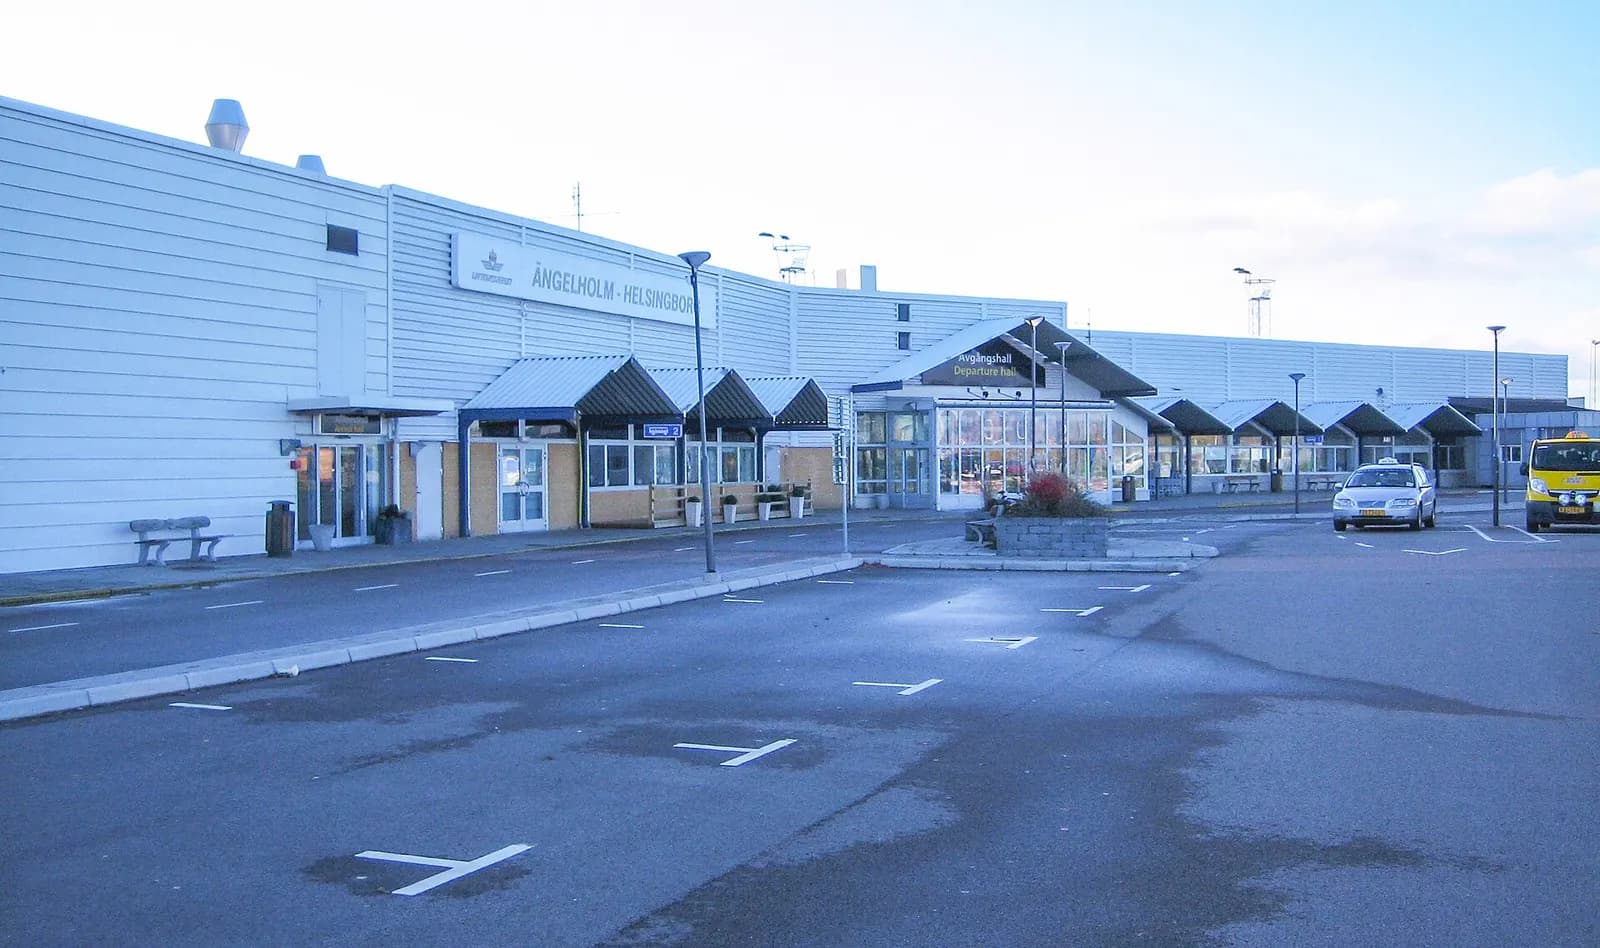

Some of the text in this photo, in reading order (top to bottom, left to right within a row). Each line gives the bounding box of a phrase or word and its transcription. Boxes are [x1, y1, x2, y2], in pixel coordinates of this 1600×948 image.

[532, 261, 614, 300] ÄNGELHOLM
[623, 284, 700, 314] HELSINGBOR
[958, 353, 1012, 365] Avgångshall
[954, 365, 1016, 377] Departure hall
[673, 427, 679, 435] 2
